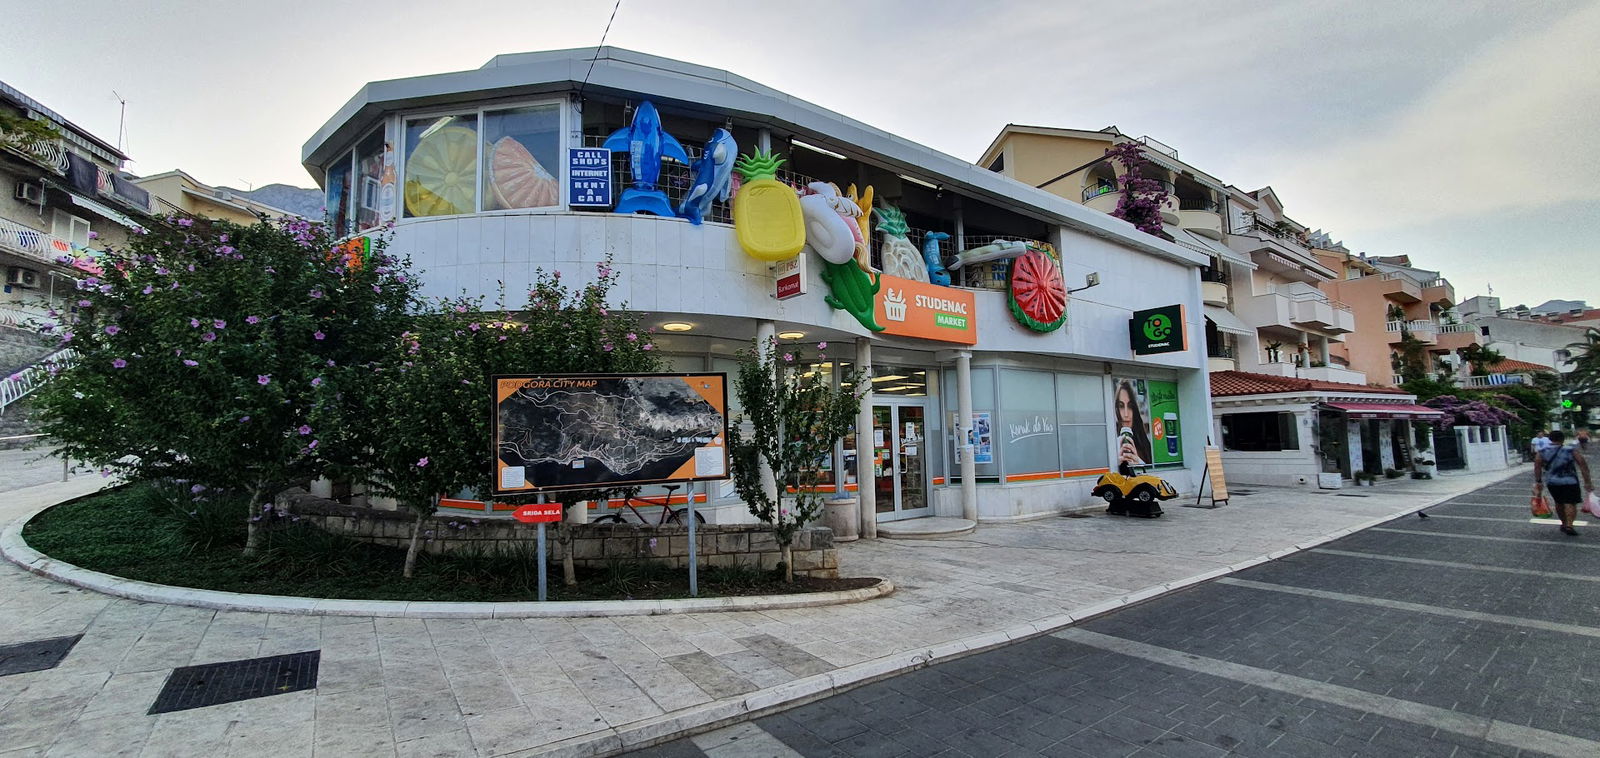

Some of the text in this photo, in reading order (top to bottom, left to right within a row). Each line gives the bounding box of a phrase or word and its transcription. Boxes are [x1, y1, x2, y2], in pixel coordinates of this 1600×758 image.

[574, 181, 606, 189] RENT
[586, 188, 594, 196] A
[778, 281, 799, 293] Bankomat
[915, 294, 968, 315] STUDENAC
[937, 315, 966, 328] MARKET
[1144, 318, 1162, 329] TO
[1153, 327, 1172, 338] GO
[1147, 341, 1170, 349] STUDENAC
[501, 380, 597, 389] PODGORA CITY MAP
